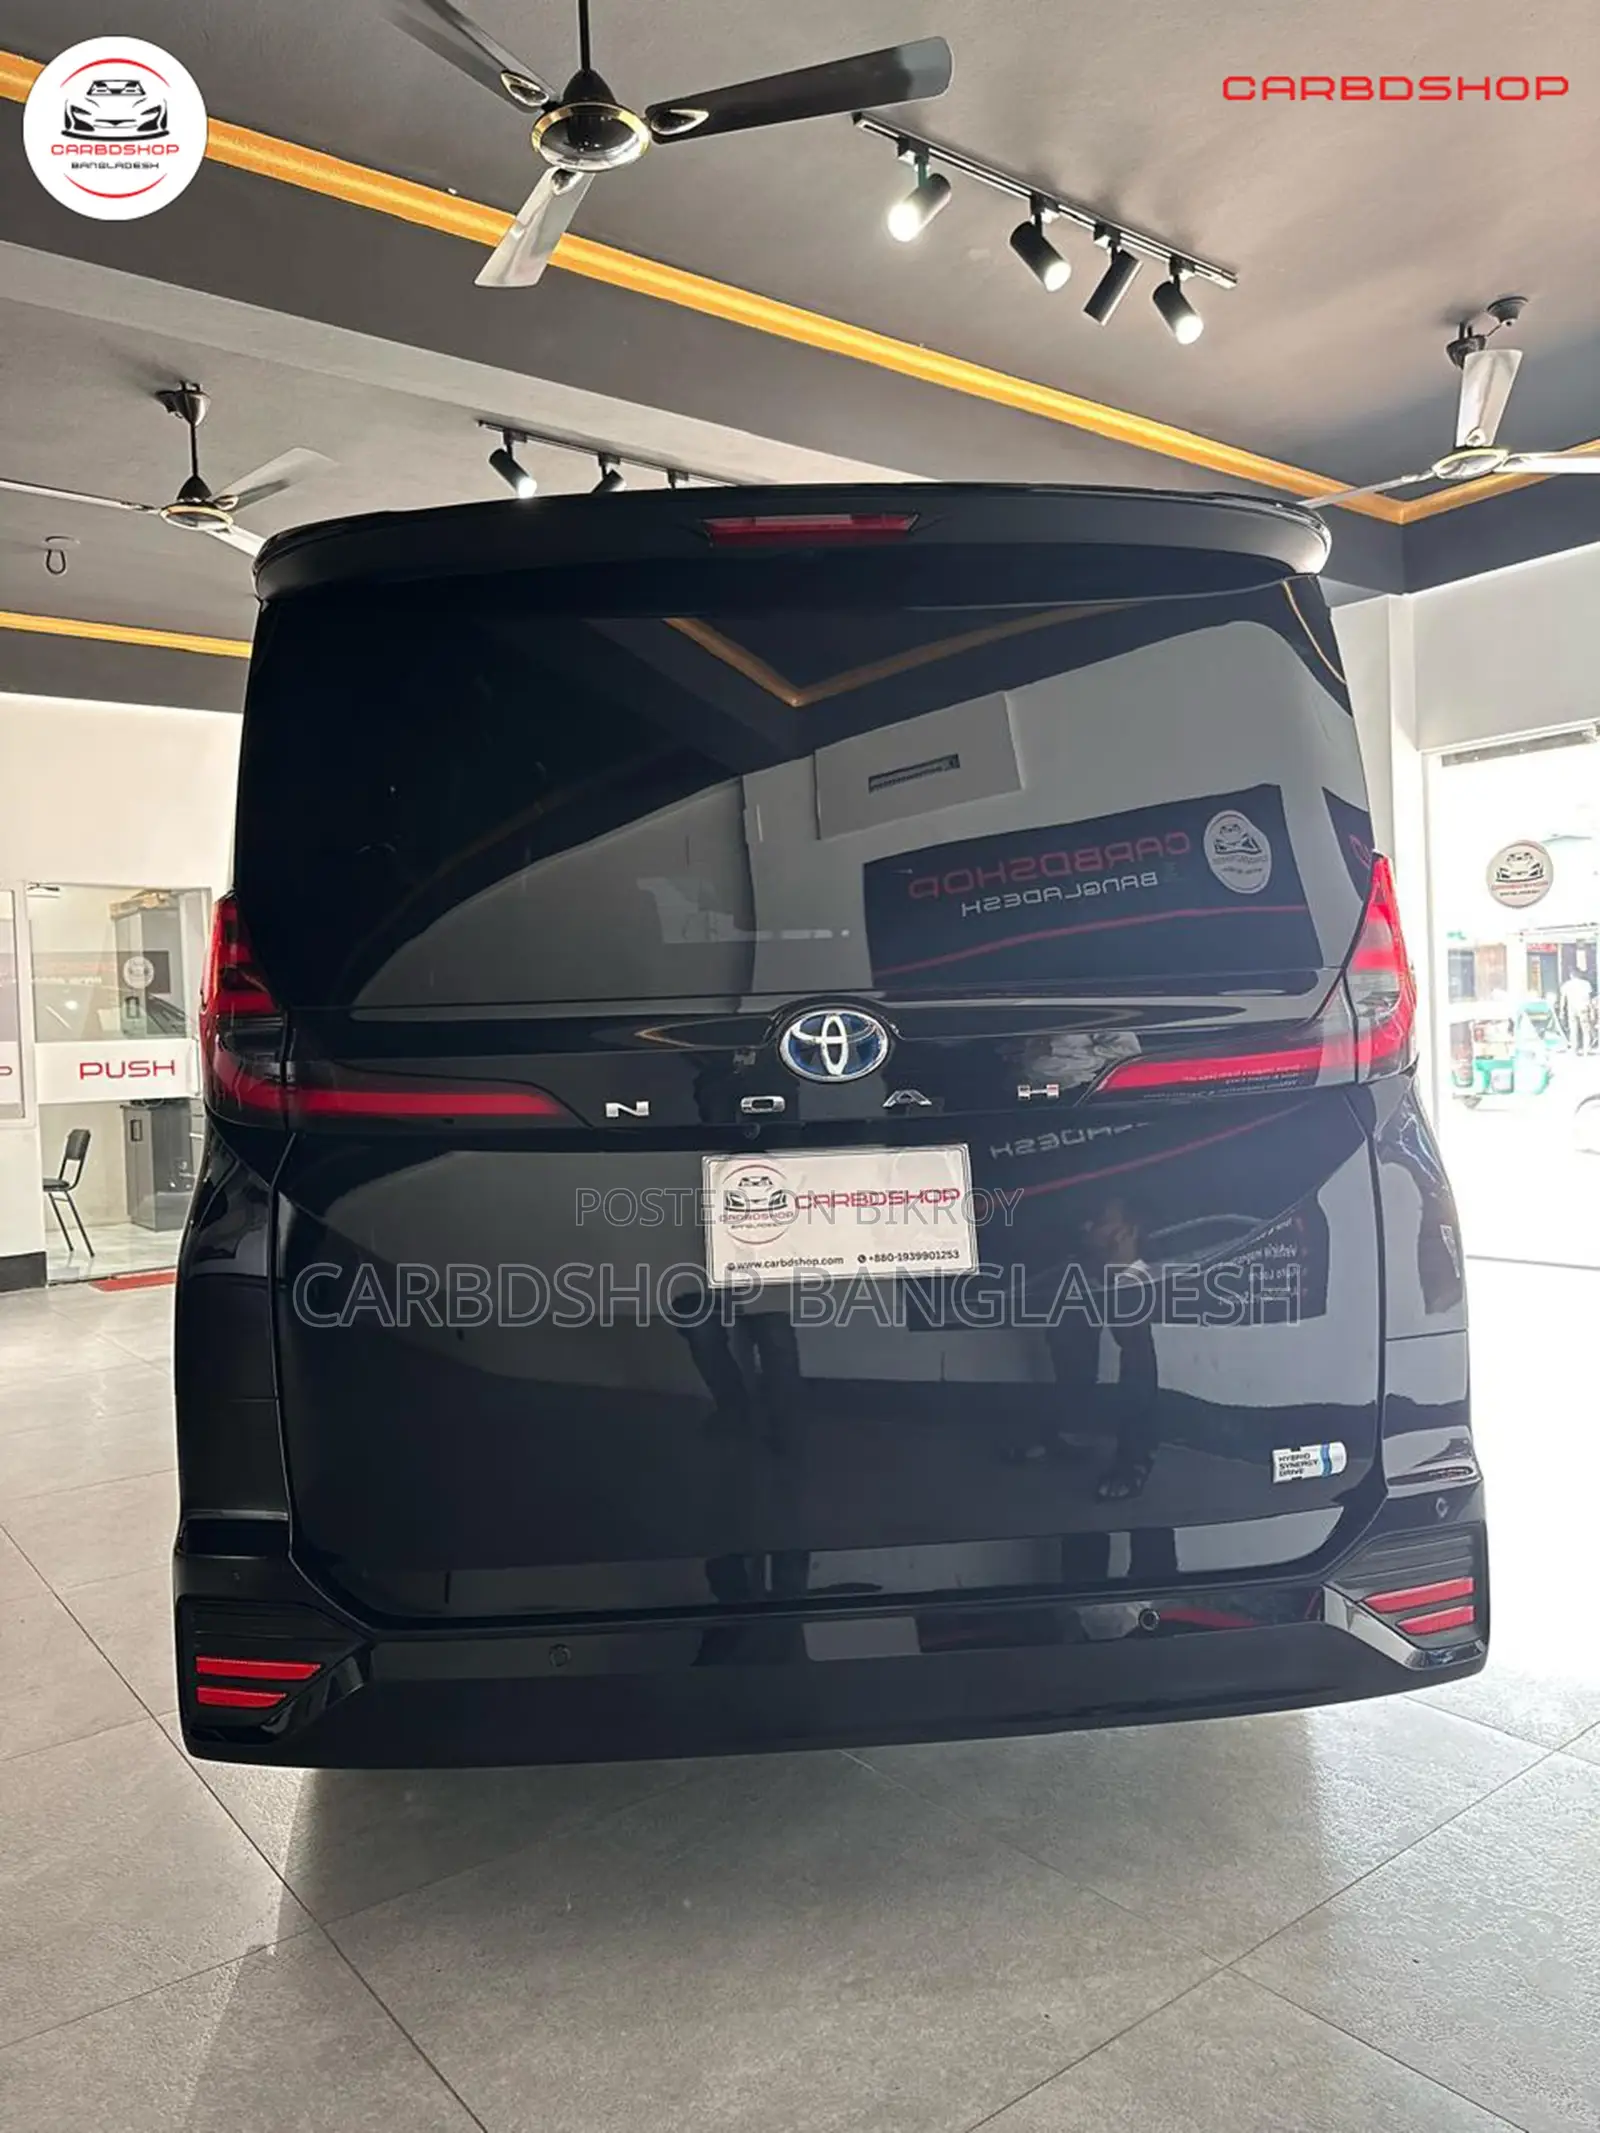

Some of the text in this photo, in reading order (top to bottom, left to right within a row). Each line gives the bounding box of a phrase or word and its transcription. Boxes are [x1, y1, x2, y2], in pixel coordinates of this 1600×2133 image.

[79, 1059, 175, 1080] PUSH
[794, 1188, 960, 1209] CARBDSHOP
[737, 1256, 845, 1269] www.carbdshop.com
